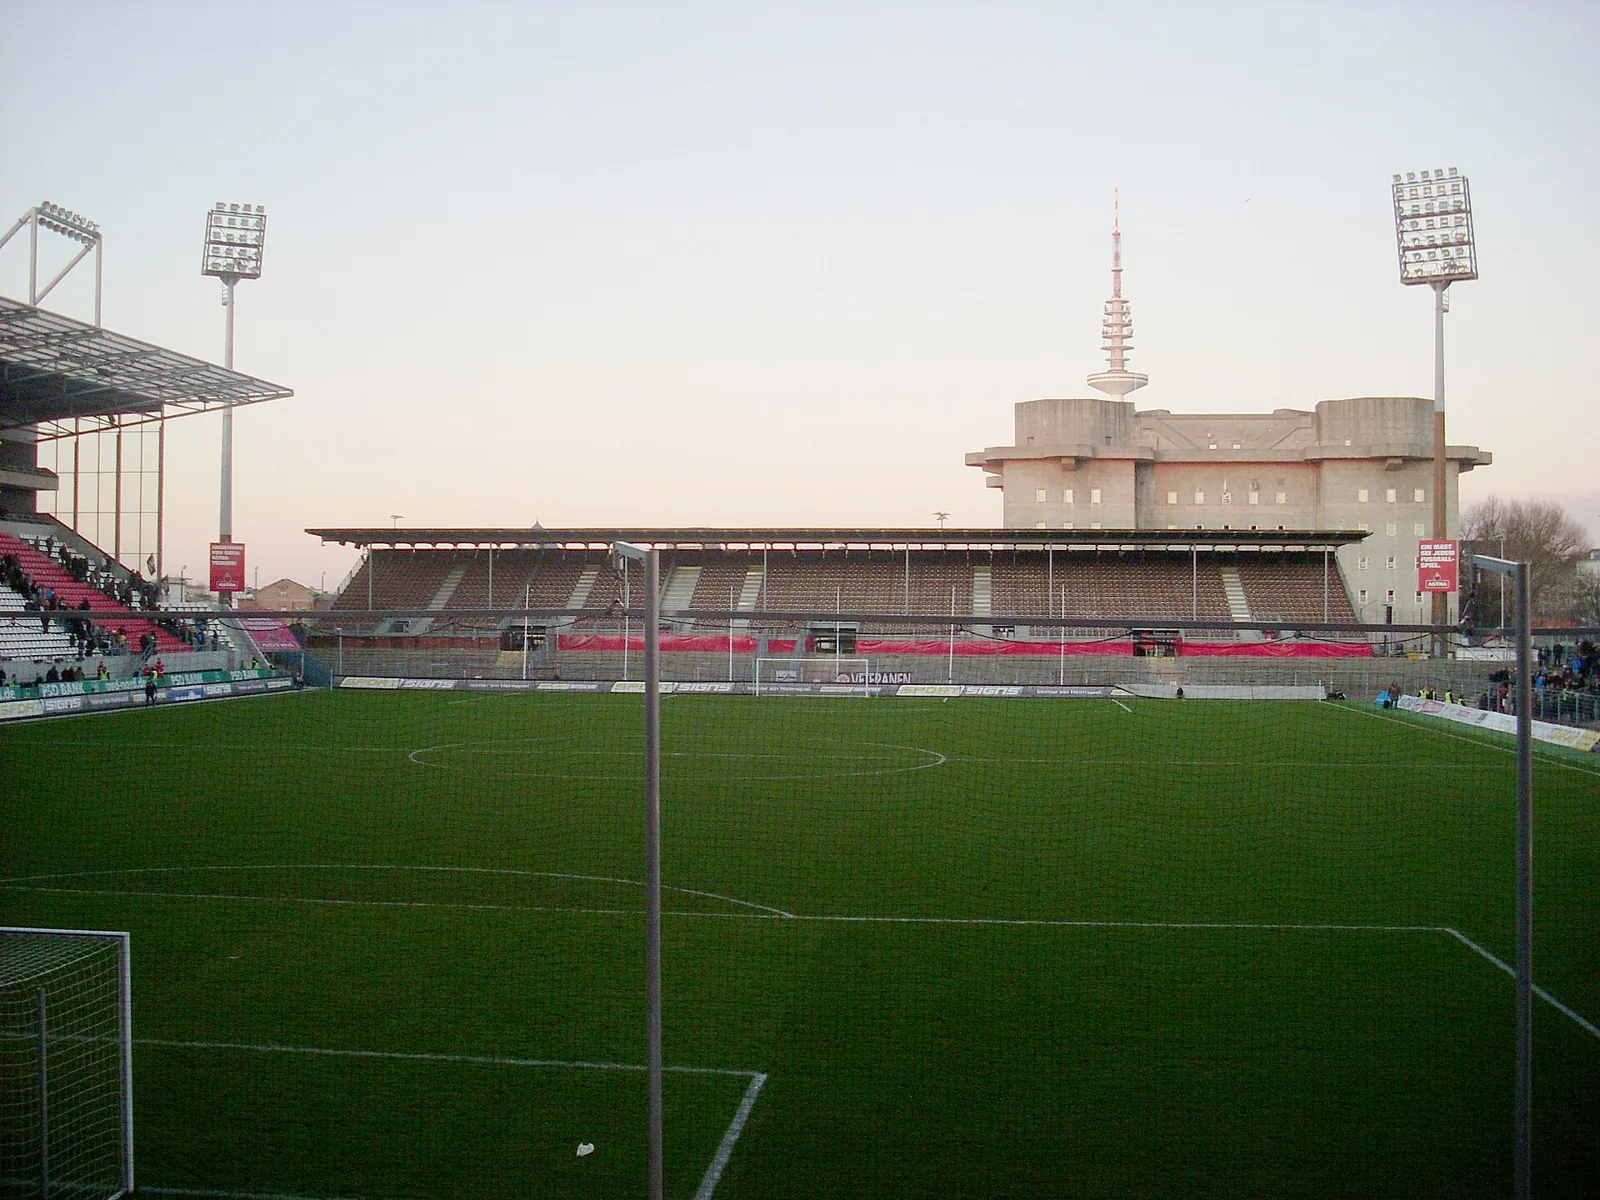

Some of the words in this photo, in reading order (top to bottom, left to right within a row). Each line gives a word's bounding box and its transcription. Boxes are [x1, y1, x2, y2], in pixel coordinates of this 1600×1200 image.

[186, 672, 203, 684] BANK
[851, 672, 911, 683] VETERANEN
[42, 685, 59, 697] PSD
[61, 682, 85, 695] BANK
